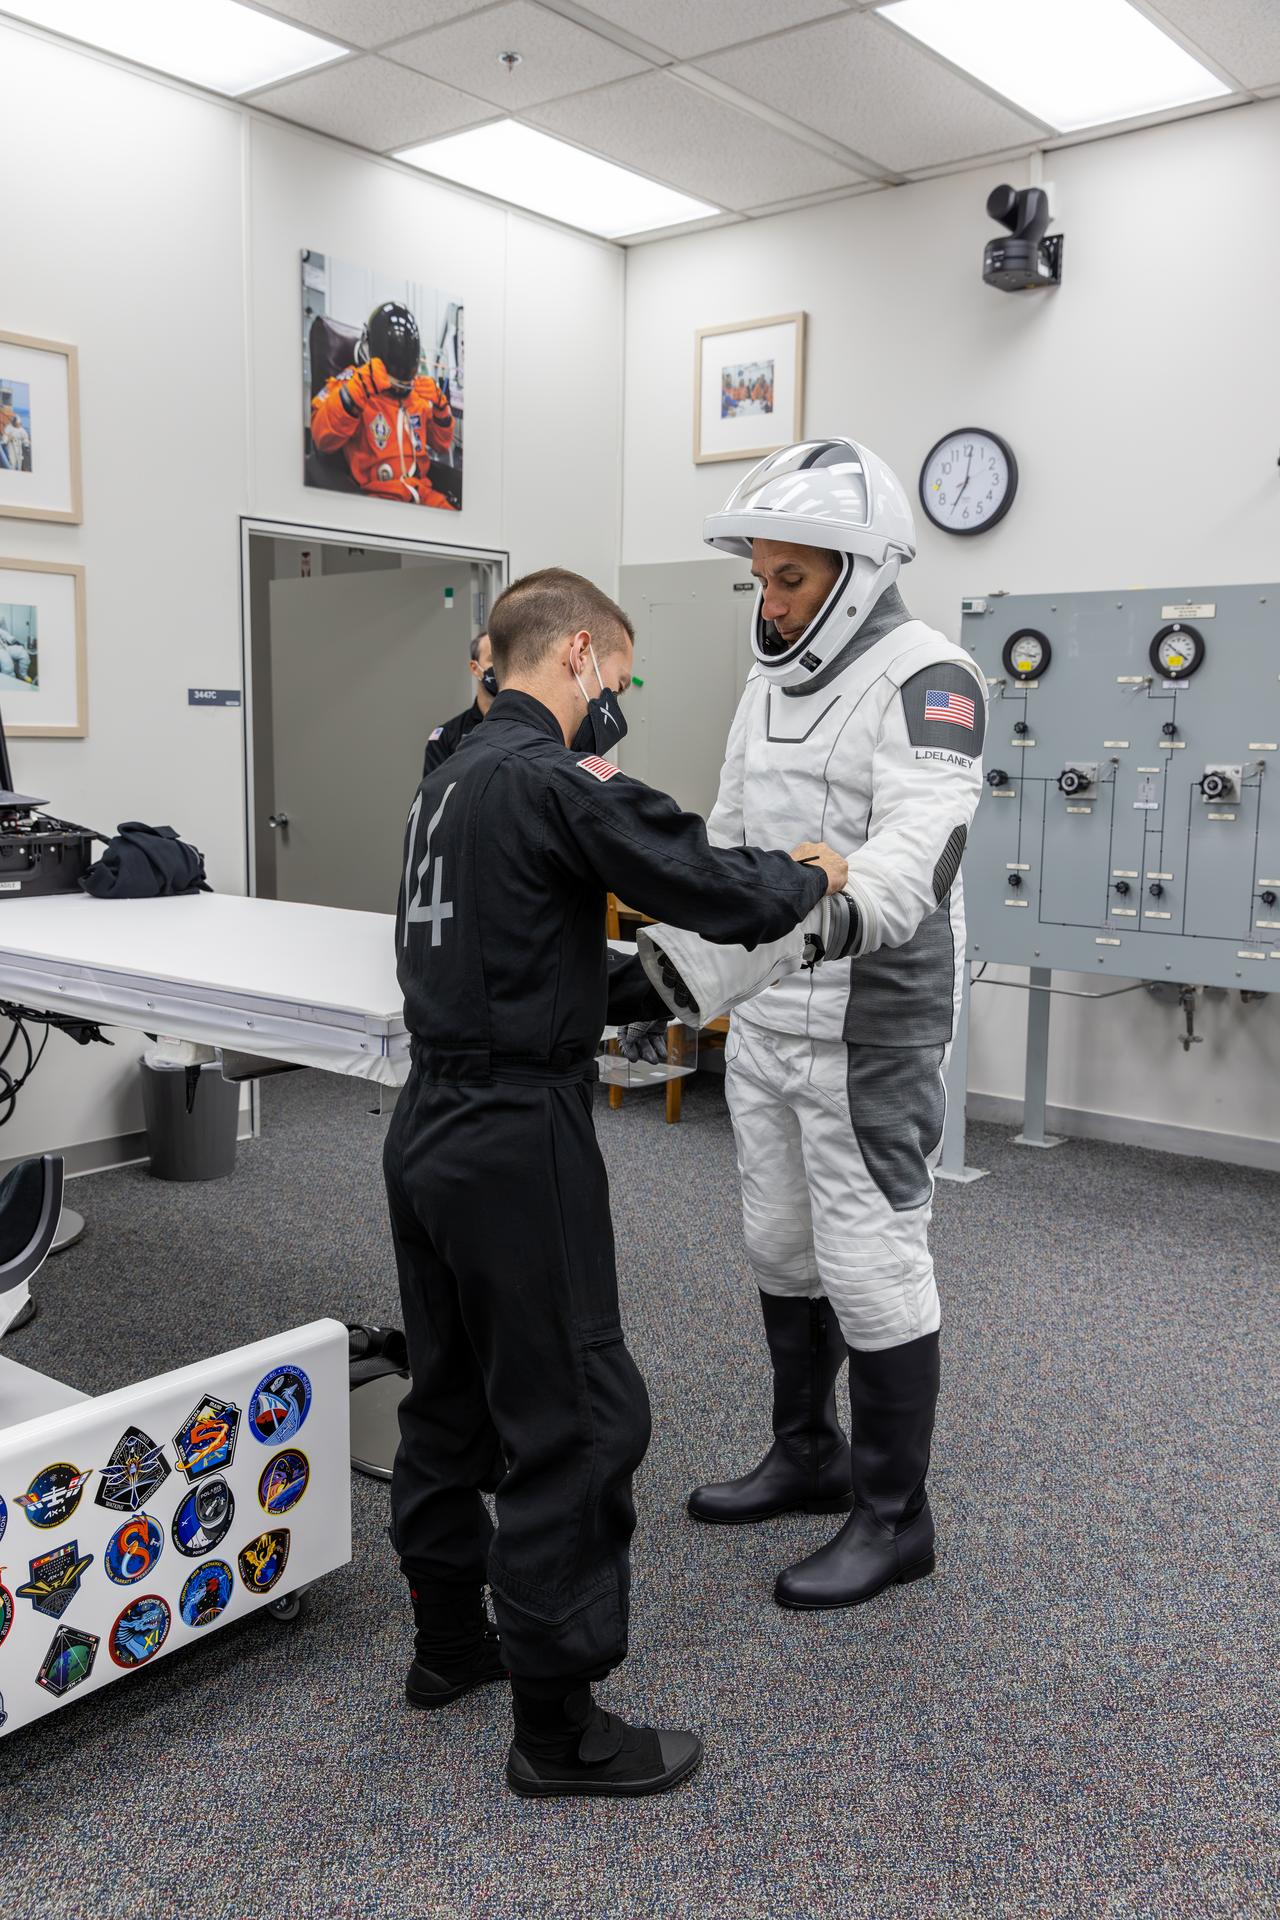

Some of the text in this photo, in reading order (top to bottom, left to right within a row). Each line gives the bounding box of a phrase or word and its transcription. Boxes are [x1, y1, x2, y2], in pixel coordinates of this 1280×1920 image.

[951, 450, 959, 462] 11
[964, 444, 974, 457] 12
[941, 462, 952, 475] 10
[988, 457, 996, 471] 2
[992, 473, 999, 486] 3
[938, 493, 946, 506] 8
[986, 490, 992, 502] 4
[962, 507, 970, 519] 6
[976, 501, 983, 514] 5
[915, 750, 974, 769] L.DELANEY
